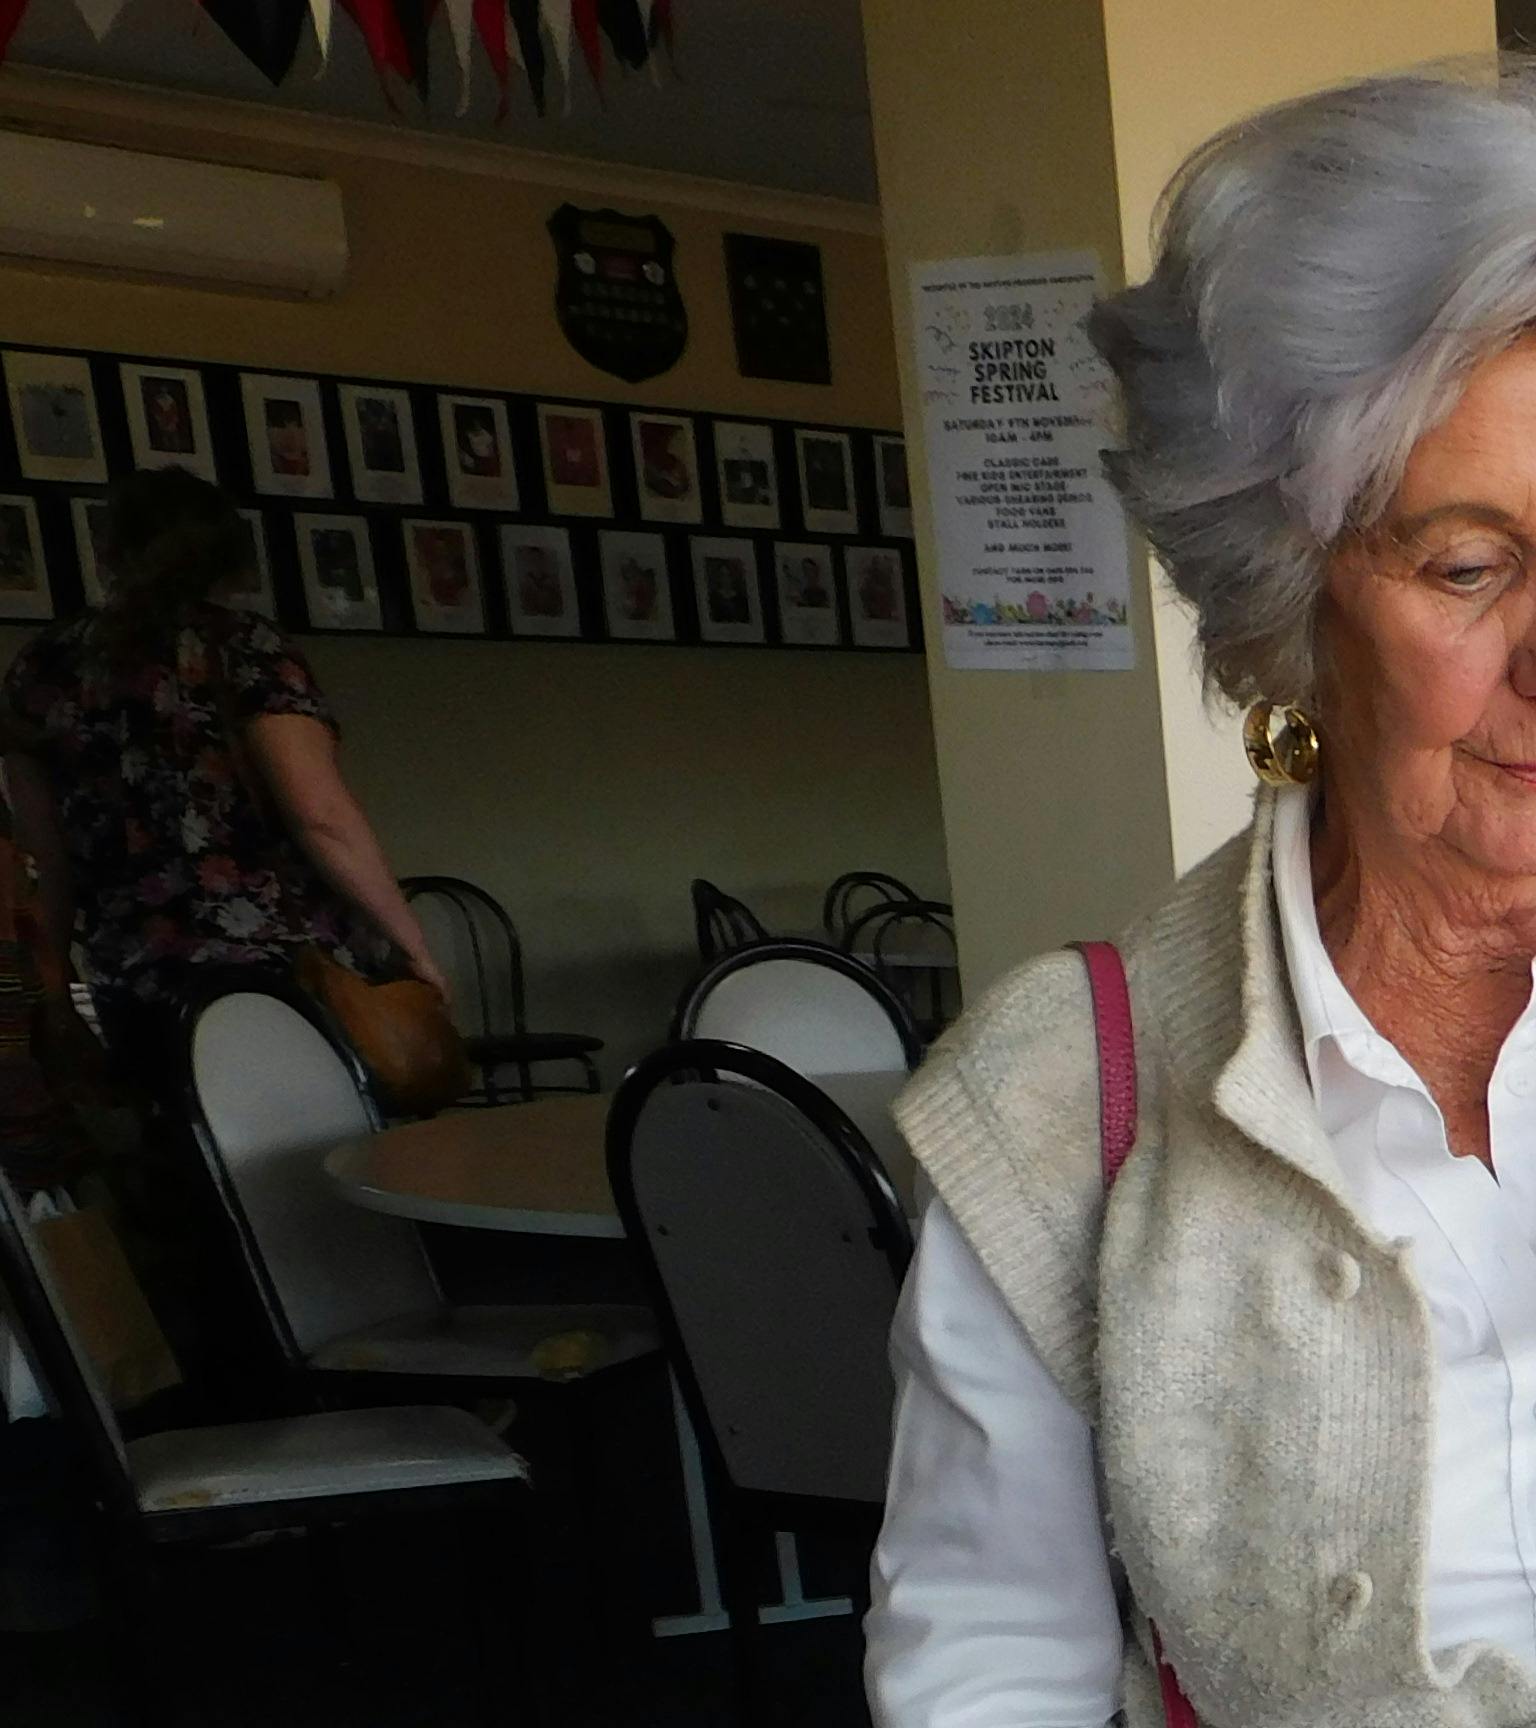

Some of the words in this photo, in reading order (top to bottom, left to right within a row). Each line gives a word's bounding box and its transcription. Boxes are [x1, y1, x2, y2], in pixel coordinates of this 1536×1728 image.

[969, 338, 1055, 361] SKIPTON
[974, 360, 1047, 382] SPRING
[970, 382, 1059, 404] FESTIVAL
[943, 418, 1003, 431] SATURDAY
